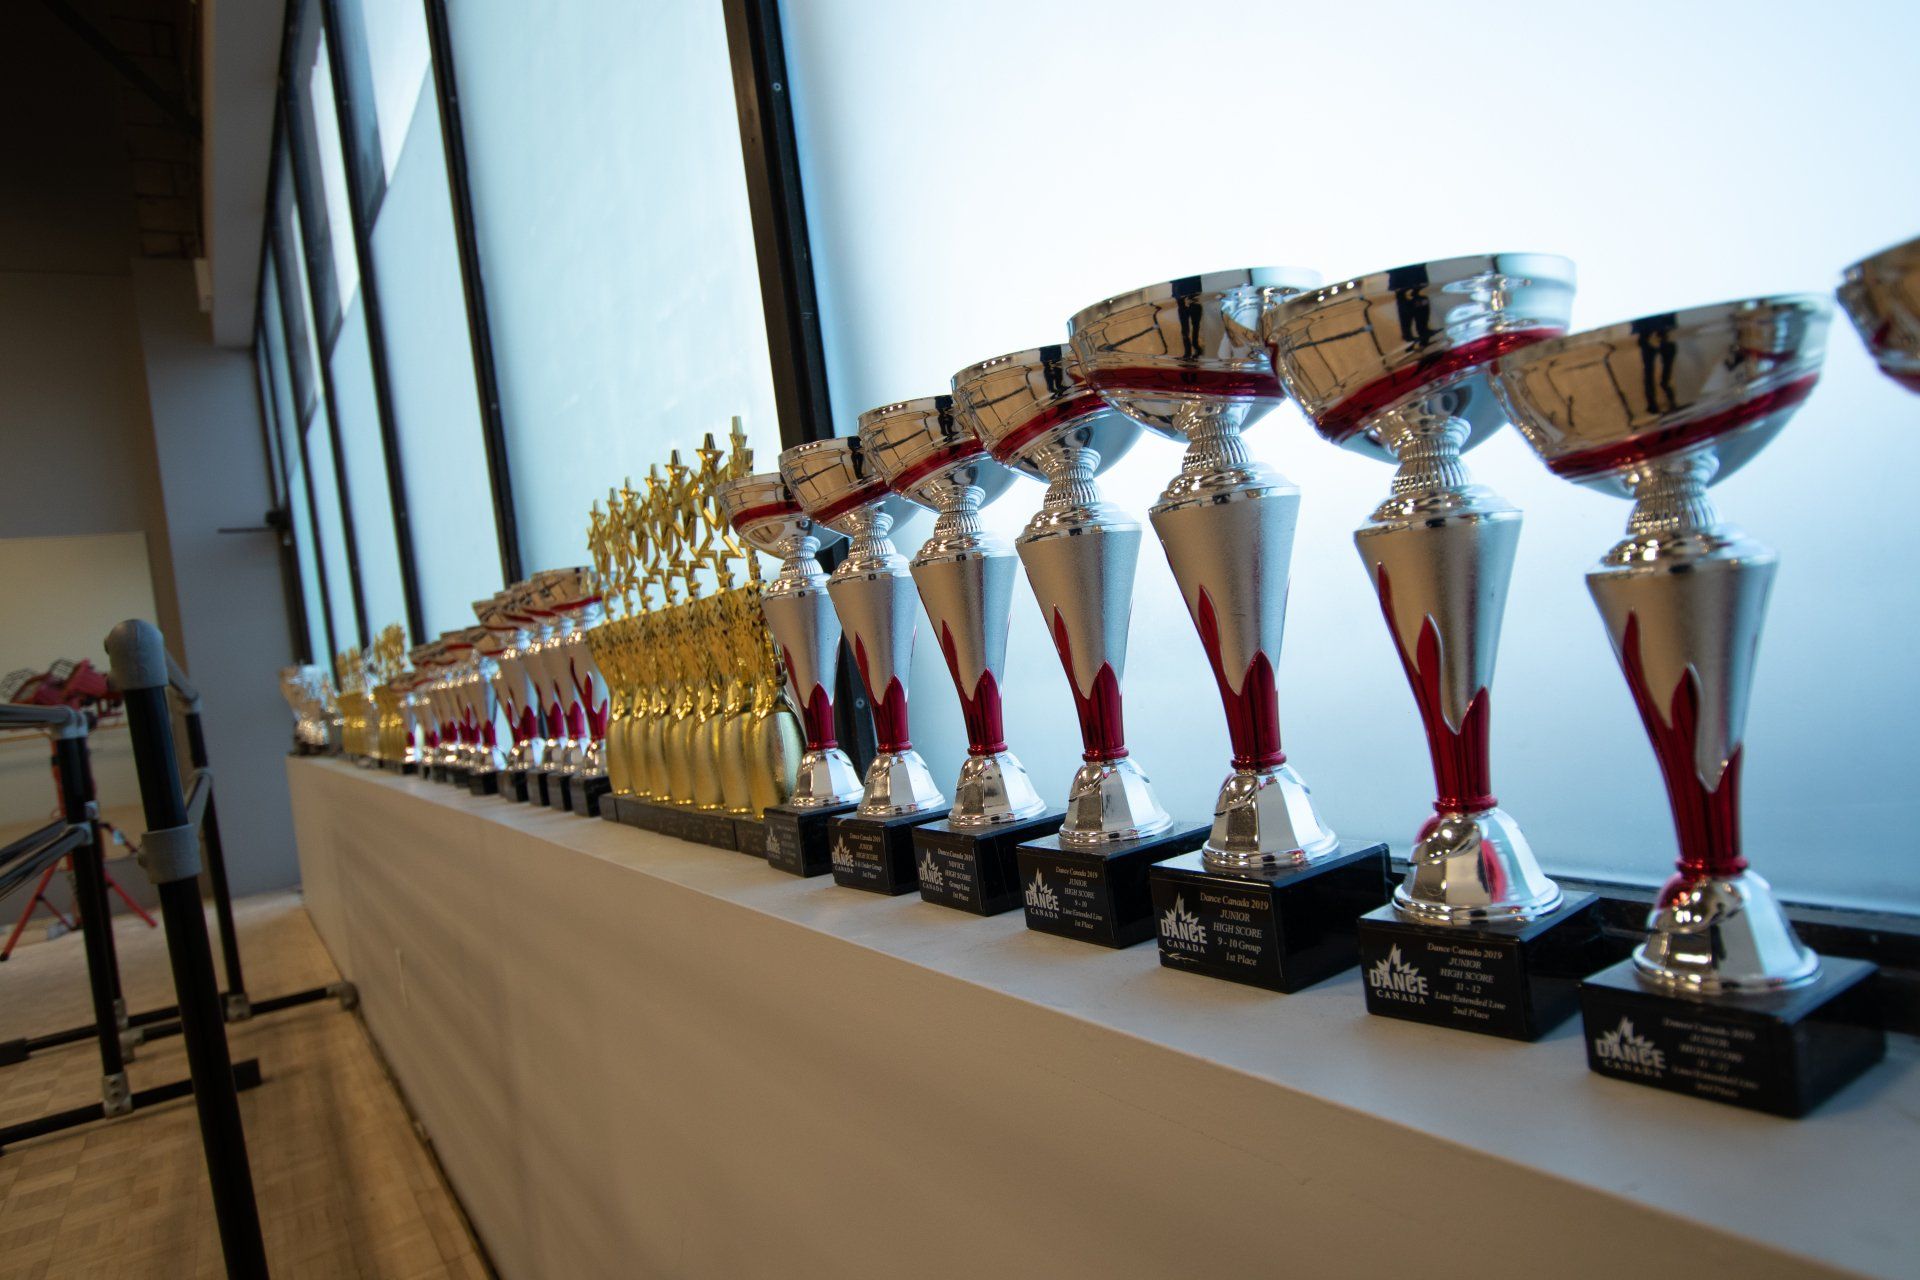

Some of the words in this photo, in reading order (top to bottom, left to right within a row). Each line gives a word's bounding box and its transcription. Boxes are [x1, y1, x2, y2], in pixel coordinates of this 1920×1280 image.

[832, 852, 854, 867] DANCE
[938, 848, 950, 856] Dance
[950, 851, 964, 860] Canada
[835, 865, 854, 874] CANADA
[919, 867, 943, 886] DANCE
[944, 869, 957, 878] HIGH
[957, 873, 972, 882] SCORE
[1056, 866, 1069, 874] Dance
[1070, 868, 1086, 877] Canada
[1087, 870, 1098, 879] 2019
[923, 882, 943, 893] CANADA
[1069, 878, 1088, 888] JUNIOR
[959, 893, 969, 902] Place
[1025, 890, 1060, 911] DANCE
[1064, 888, 1078, 896] HIGH
[1078, 889, 1095, 899] SCORE
[1201, 892, 1221, 903] Dance
[1223, 896, 1250, 908] Canada
[1252, 899, 1269, 910] 2019
[1030, 907, 1059, 919] CANADA
[1093, 913, 1103, 921] Line
[1220, 909, 1250, 922] JUNIOR
[1081, 921, 1094, 929] Place
[1161, 918, 1207, 945] DANCE
[1213, 922, 1234, 933] HIGH
[1235, 925, 1263, 939] SCORE
[1166, 939, 1205, 953] CANADA
[1217, 937, 1223, 945] 9
[1229, 939, 1238, 948] 10
[1238, 940, 1262, 955] Group
[1427, 943, 1450, 953] Dance
[1452, 946, 1482, 957] Canada
[1484, 949, 1503, 959] 2019
[1226, 952, 1235, 962] 1st
[1237, 954, 1257, 966] Place
[1449, 957, 1482, 969] JUNIOR
[1369, 969, 1429, 995] DANCE
[1440, 968, 1463, 979] HIGH
[1465, 972, 1495, 983] SCORE
[1456, 983, 1464, 991] 11
[1472, 985, 1482, 994] 12
[1376, 989, 1426, 1005] CANADA
[1488, 1000, 1506, 1010] Line
[1453, 1006, 1467, 1016] 2nd
[1467, 1009, 1489, 1020] Place
[1595, 1038, 1666, 1069] DANCE
[1604, 1060, 1663, 1078] CANADA
